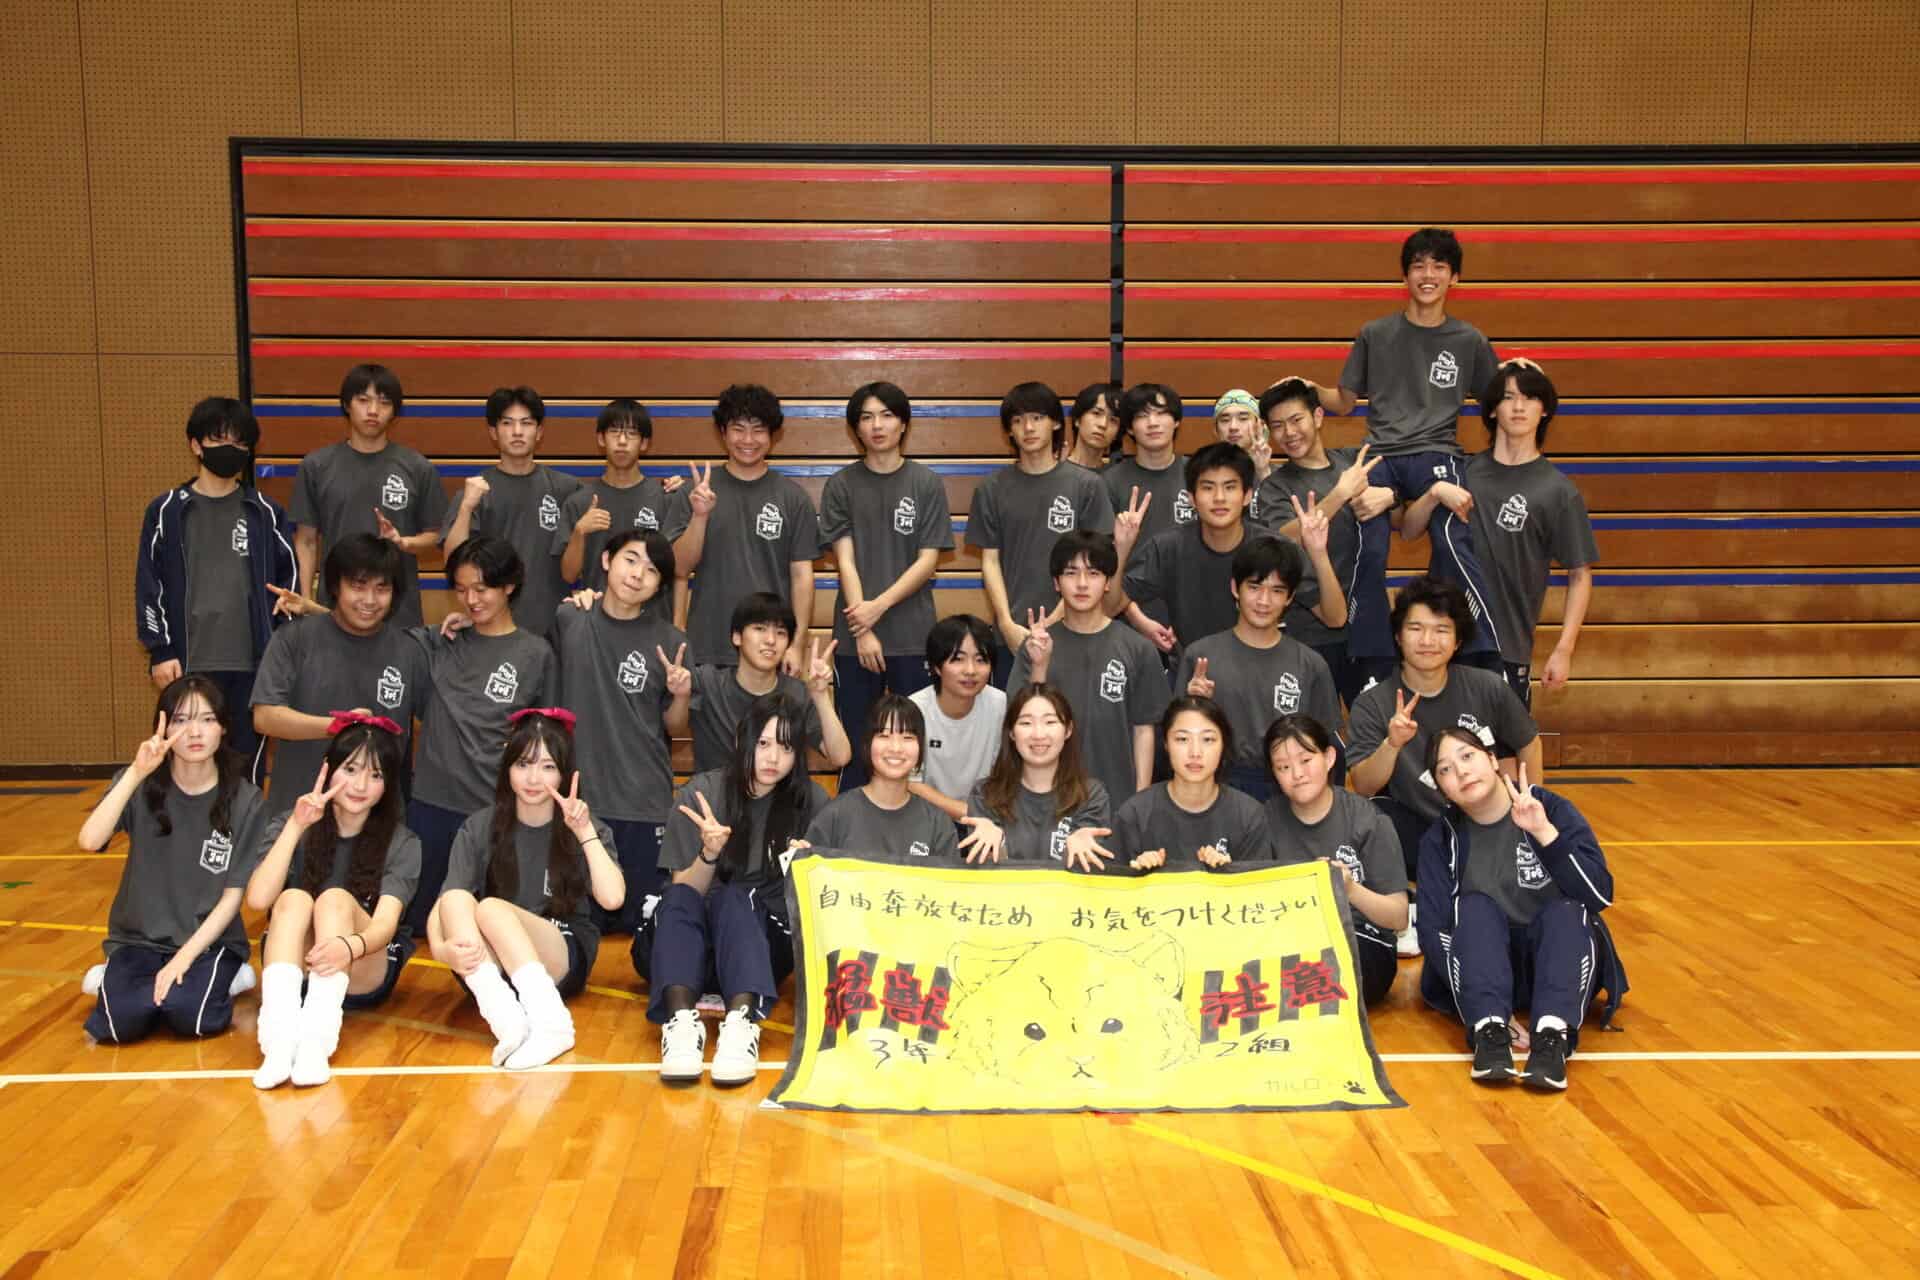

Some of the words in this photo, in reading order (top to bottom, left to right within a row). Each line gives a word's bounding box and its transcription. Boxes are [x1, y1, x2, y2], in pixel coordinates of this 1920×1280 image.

[819, 884, 1033, 927] 自由奔放なため
[1071, 894, 1318, 932] お気をつけください
[824, 959, 950, 1031] 猛獣
[1200, 960, 1349, 1029] 注意
